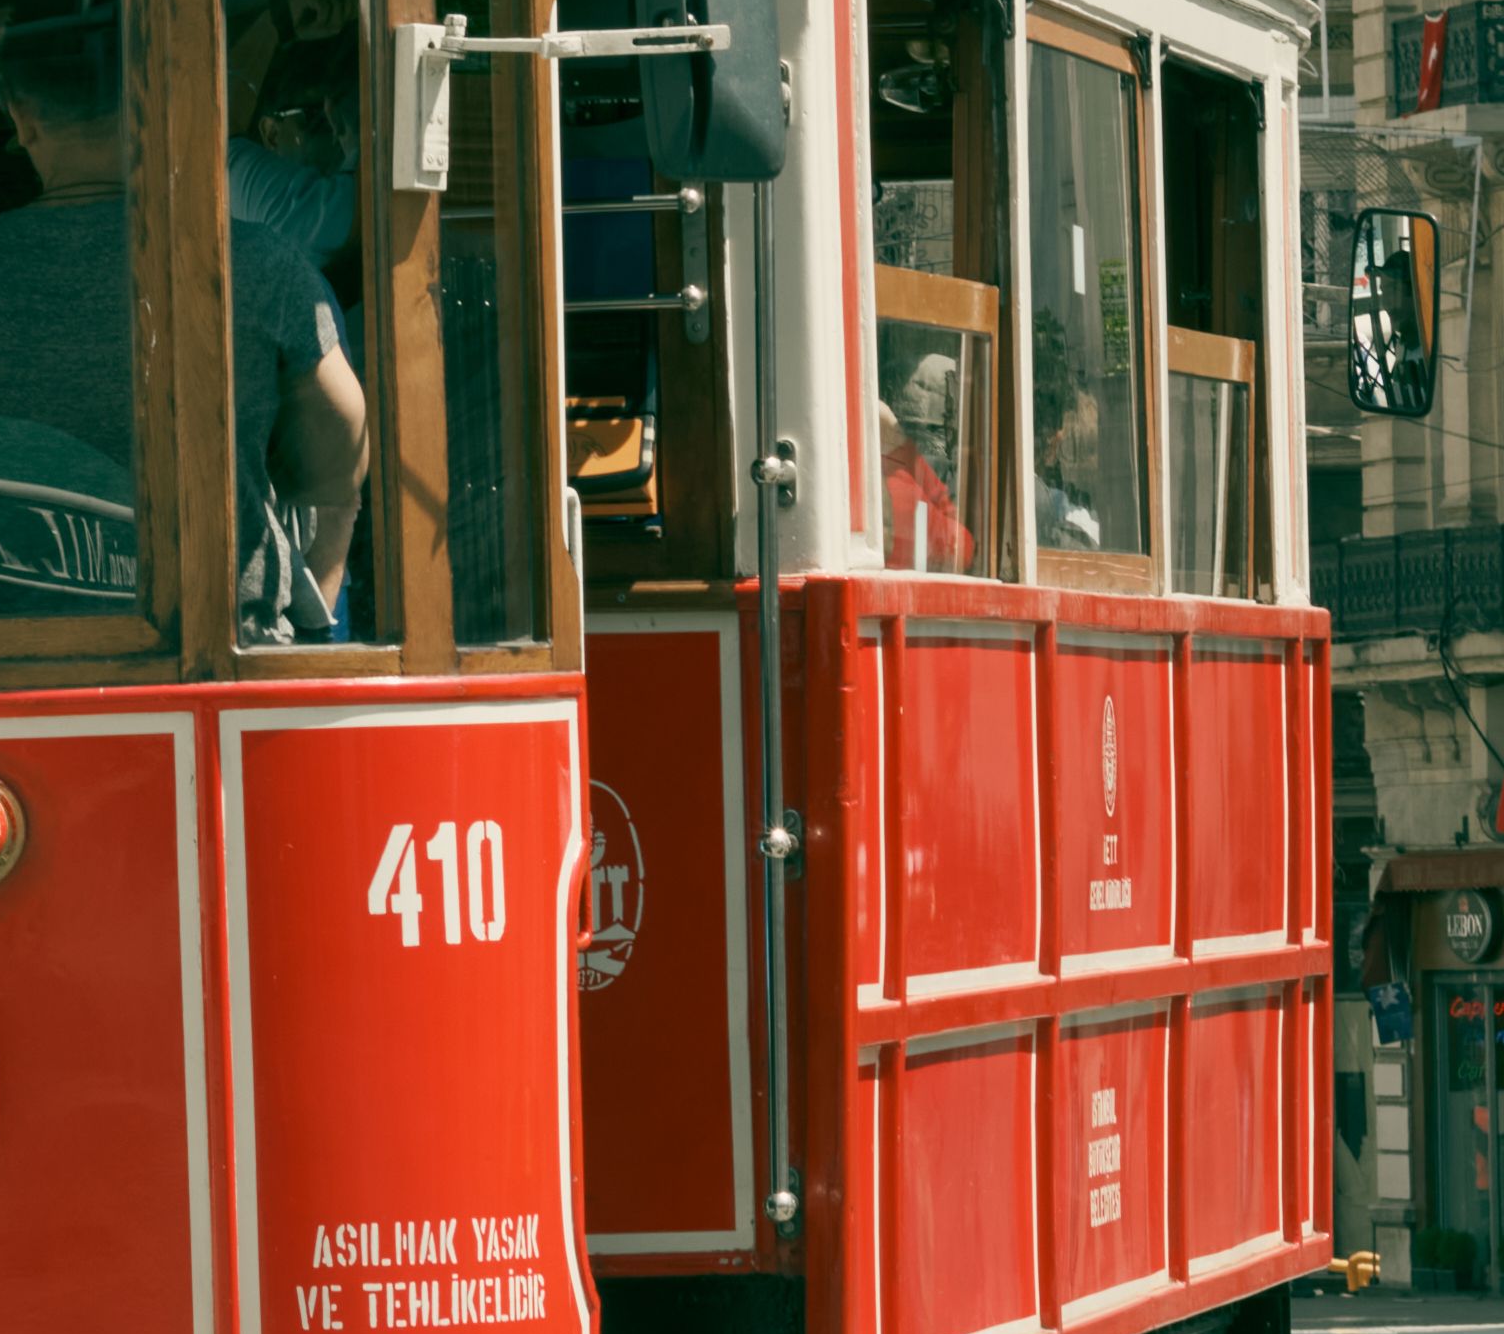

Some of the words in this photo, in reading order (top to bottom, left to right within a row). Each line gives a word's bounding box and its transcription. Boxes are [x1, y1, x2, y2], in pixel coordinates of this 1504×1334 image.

[368, 819, 506, 948] 410
[1446, 913, 1483, 938] LEBON
[312, 1217, 458, 1269] ASILMAK
[471, 1213, 540, 1264] YASAK
[296, 1284, 343, 1331] VE
[362, 1267, 546, 1330] TEHLİKELİDİR
